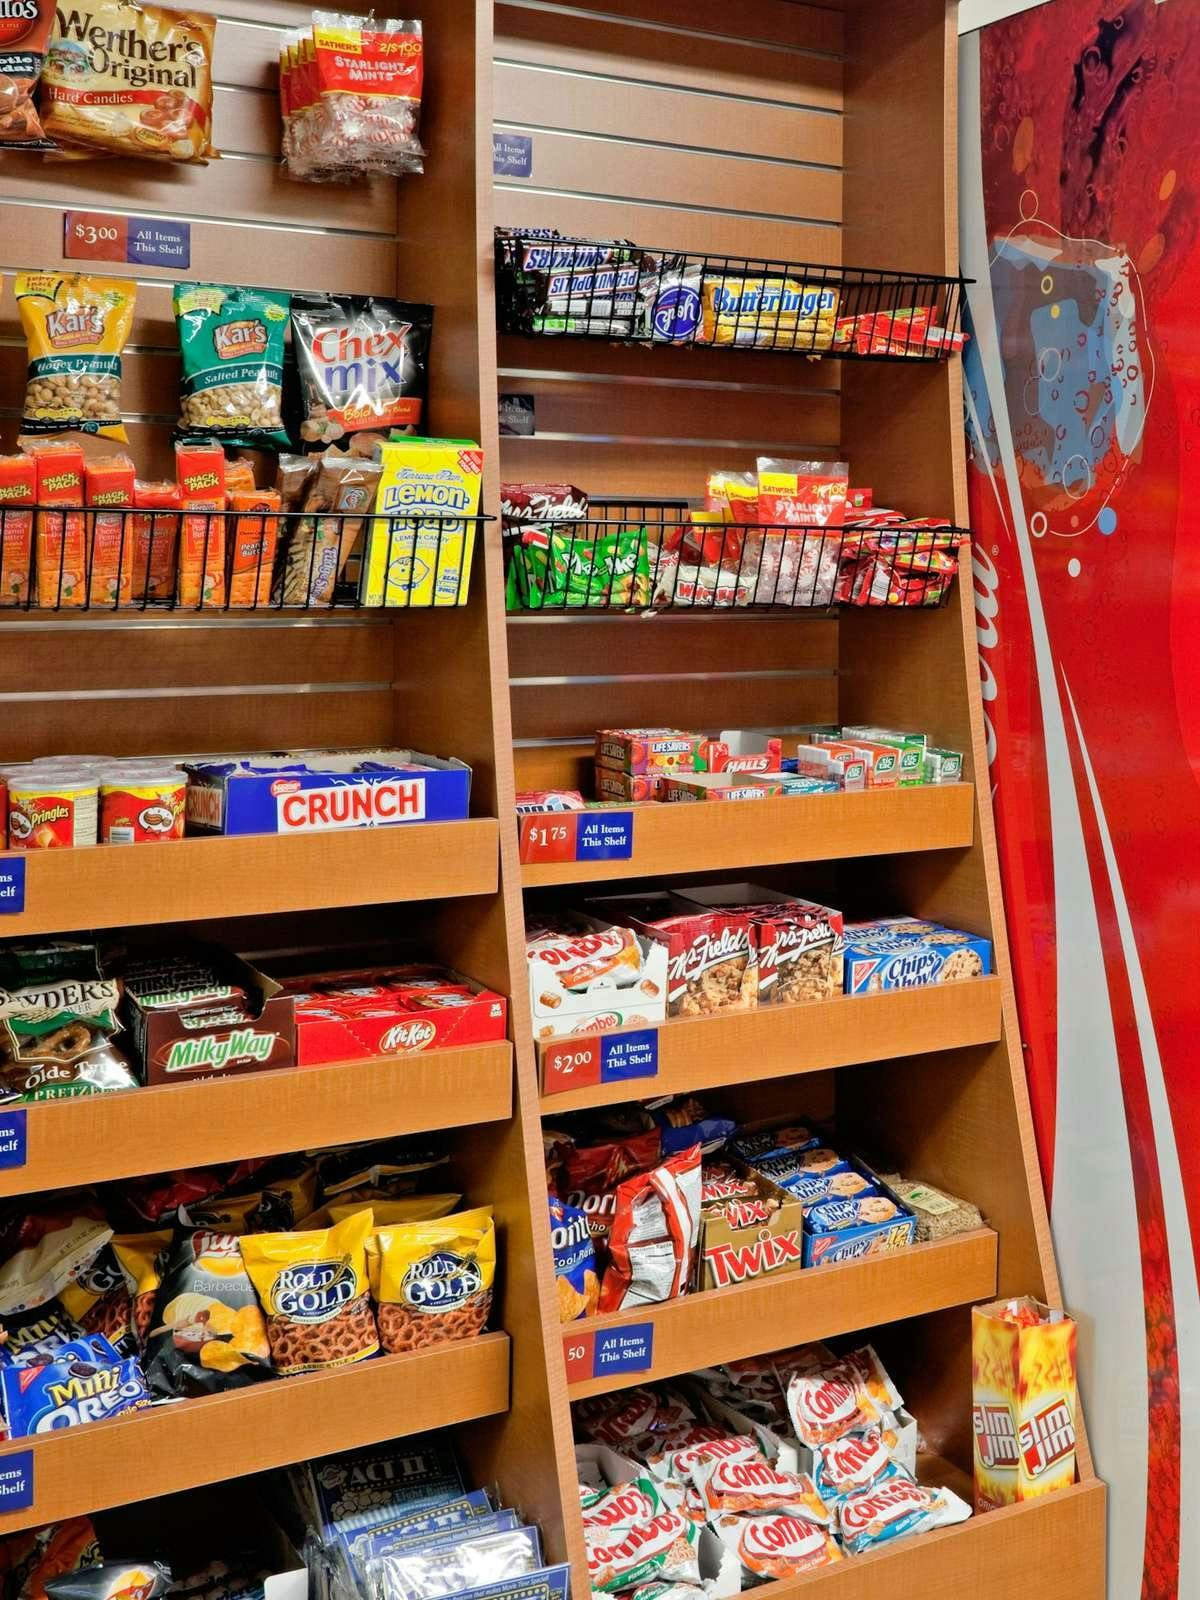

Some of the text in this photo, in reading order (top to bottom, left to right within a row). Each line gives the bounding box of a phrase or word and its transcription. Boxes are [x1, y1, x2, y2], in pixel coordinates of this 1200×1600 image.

[56, 6, 204, 62] Werther's
[88, 46, 197, 88] Original
[335, 56, 405, 71] STARLIGHT
[349, 70, 393, 81] MINTS
[49, 87, 134, 104] Hard Candies
[504, 144, 525, 154] Items
[508, 155, 527, 166] Shelf
[136, 230, 152, 239] All
[155, 231, 181, 243] Items
[134, 242, 183, 255] This Shelf
[714, 286, 835, 316] Butterfinger
[47, 308, 104, 339] Kar's
[213, 320, 267, 352] Kar's
[312, 324, 413, 363] Chex
[204, 371, 239, 385] Salted
[325, 358, 408, 393] mix
[42, 473, 75, 487] SNACK
[49, 477, 80, 492] PACK
[184, 472, 216, 486] SNACK
[190, 477, 220, 491] PACK
[92, 490, 124, 502] SNACK
[98, 494, 129, 506] PACK
[726, 759, 768, 773] HALLS
[283, 783, 419, 827] CRUNCH
[31, 805, 69, 828] Pringles
[584, 825, 598, 834] All
[601, 824, 625, 834] Items
[582, 836, 626, 847] This Shelf
[888, 951, 936, 980] Chips
[609, 1045, 624, 1056] All
[626, 1043, 650, 1053] Items
[607, 1053, 652, 1069] This Shelf
[25, 1064, 71, 1089] Olde
[34, 1084, 118, 1101] PRETZE
[787, 1177, 823, 1194] Chips
[816, 1200, 853, 1217] Chips
[888, 1225, 911, 1241] 12
[704, 1229, 801, 1288] Twix
[409, 1258, 457, 1281] ROLD
[194, 1279, 255, 1292] Barbecue
[278, 1270, 334, 1290] ROLD
[275, 1280, 355, 1314] GOLD
[405, 1273, 483, 1305] GOLD
[568, 1337, 644, 1361] 50 All Items
[600, 1347, 646, 1363] This Shelf
[49, 1366, 121, 1407] Mini
[36, 1381, 143, 1435] OREO
[350, 1462, 393, 1484] ACT
